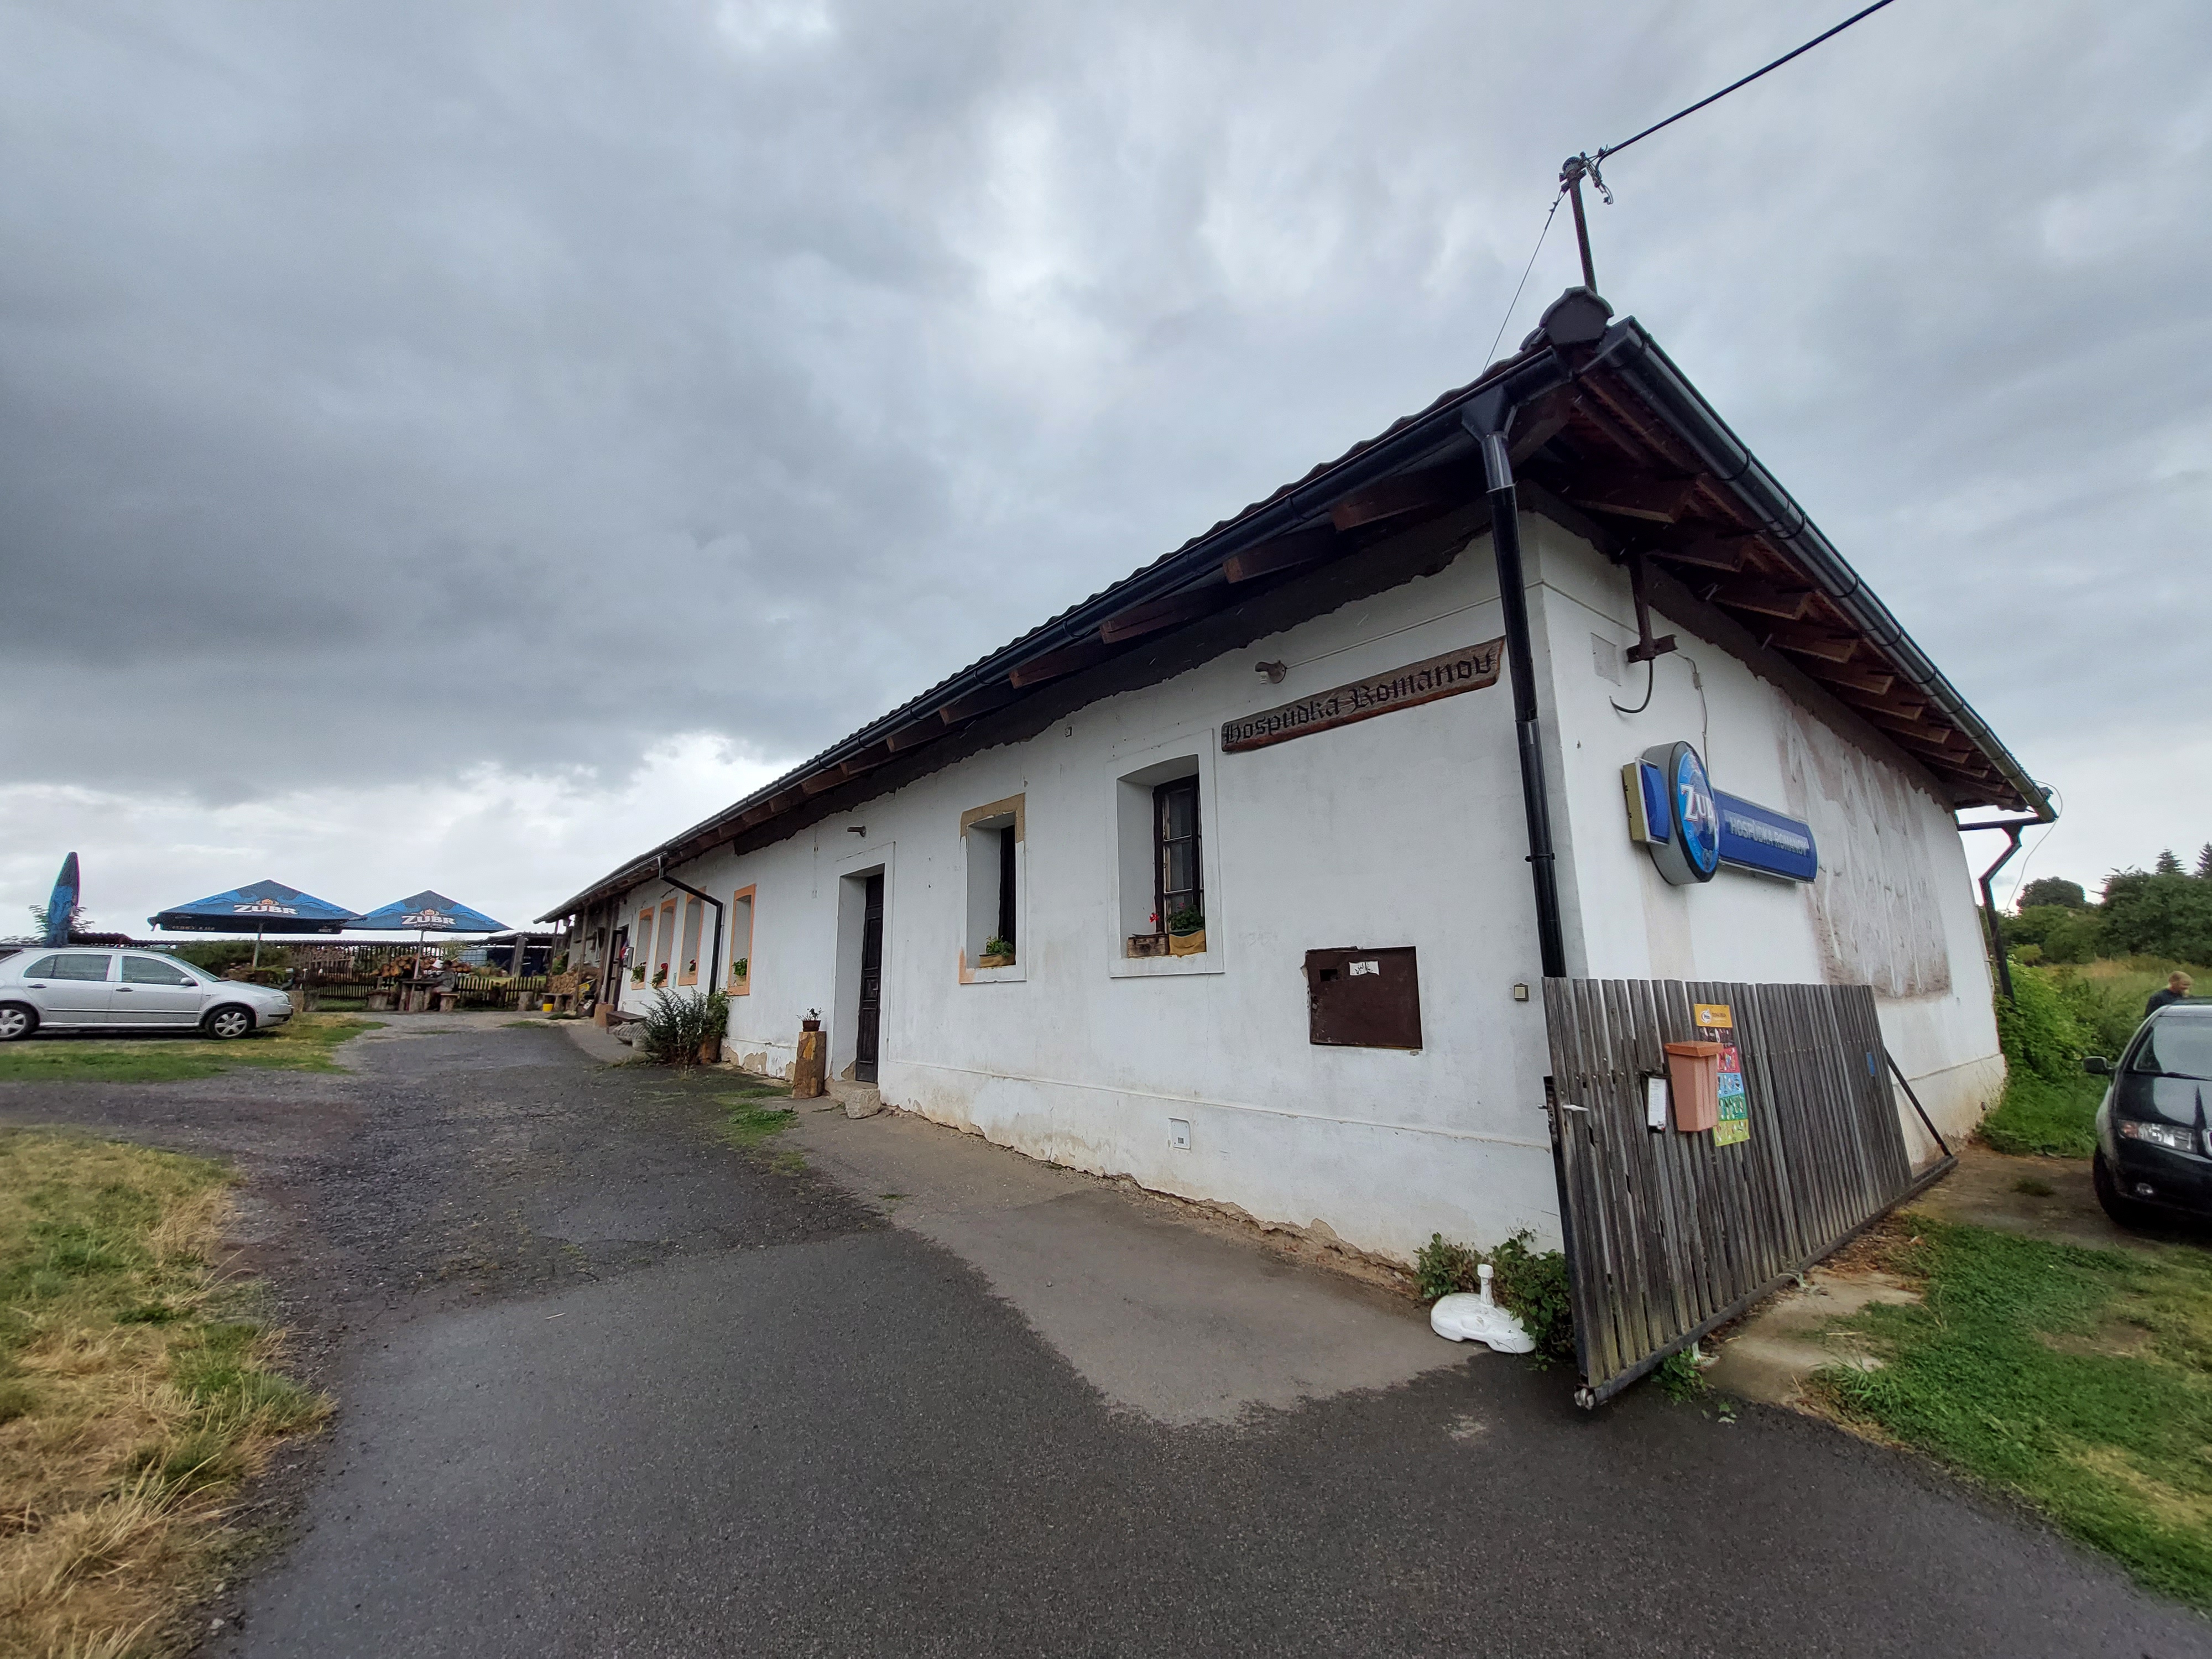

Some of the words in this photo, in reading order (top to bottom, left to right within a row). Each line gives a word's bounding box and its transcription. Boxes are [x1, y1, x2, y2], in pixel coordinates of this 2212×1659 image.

[1348, 647, 1496, 713] Romanov
[1679, 782, 1715, 822] ZUB
[233, 905, 299, 915] ZUBR
[401, 915, 456, 925] ZUBR
